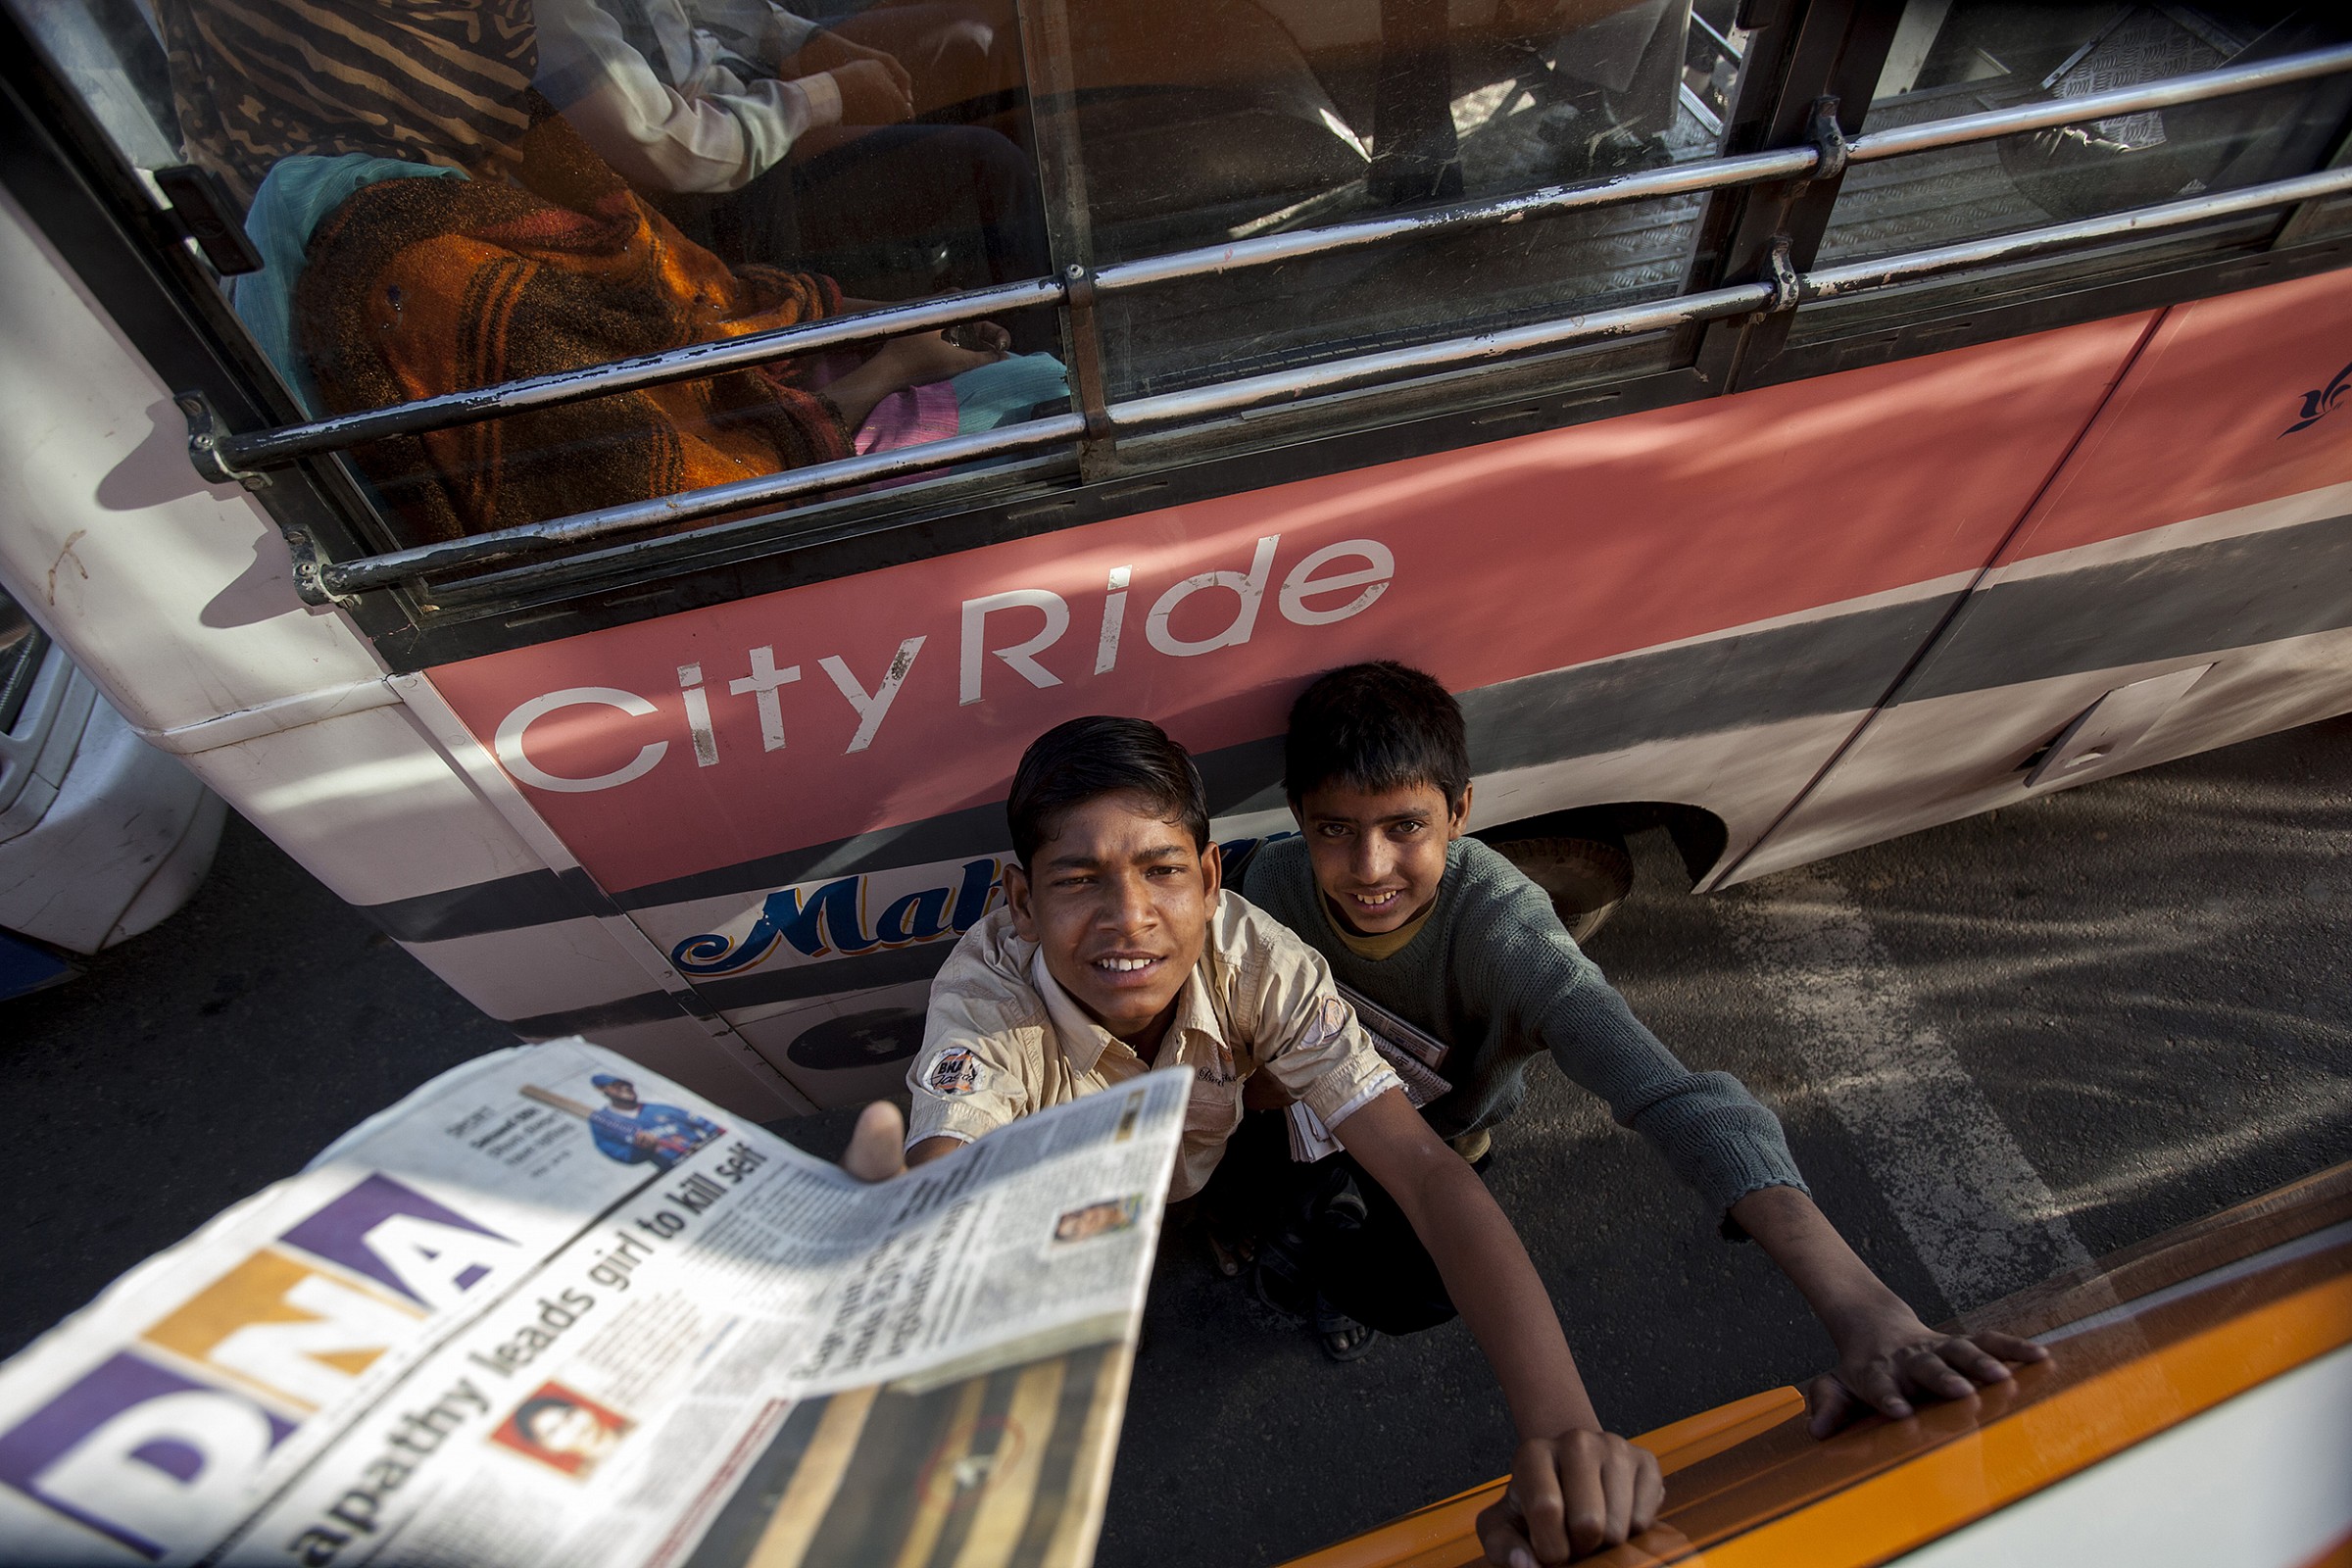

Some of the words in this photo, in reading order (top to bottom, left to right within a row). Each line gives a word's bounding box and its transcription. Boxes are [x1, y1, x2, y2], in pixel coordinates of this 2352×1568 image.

[495, 635, 927, 793] City
[959, 534, 1395, 706] Ride
[20, 1211, 521, 1560] DNA
[284, 1376, 491, 1568] apathy
[467, 1286, 595, 1378] leads
[588, 1230, 655, 1293] girl
[635, 1210, 686, 1241] to
[663, 1170, 728, 1216] kill
[714, 1140, 768, 1185] self
